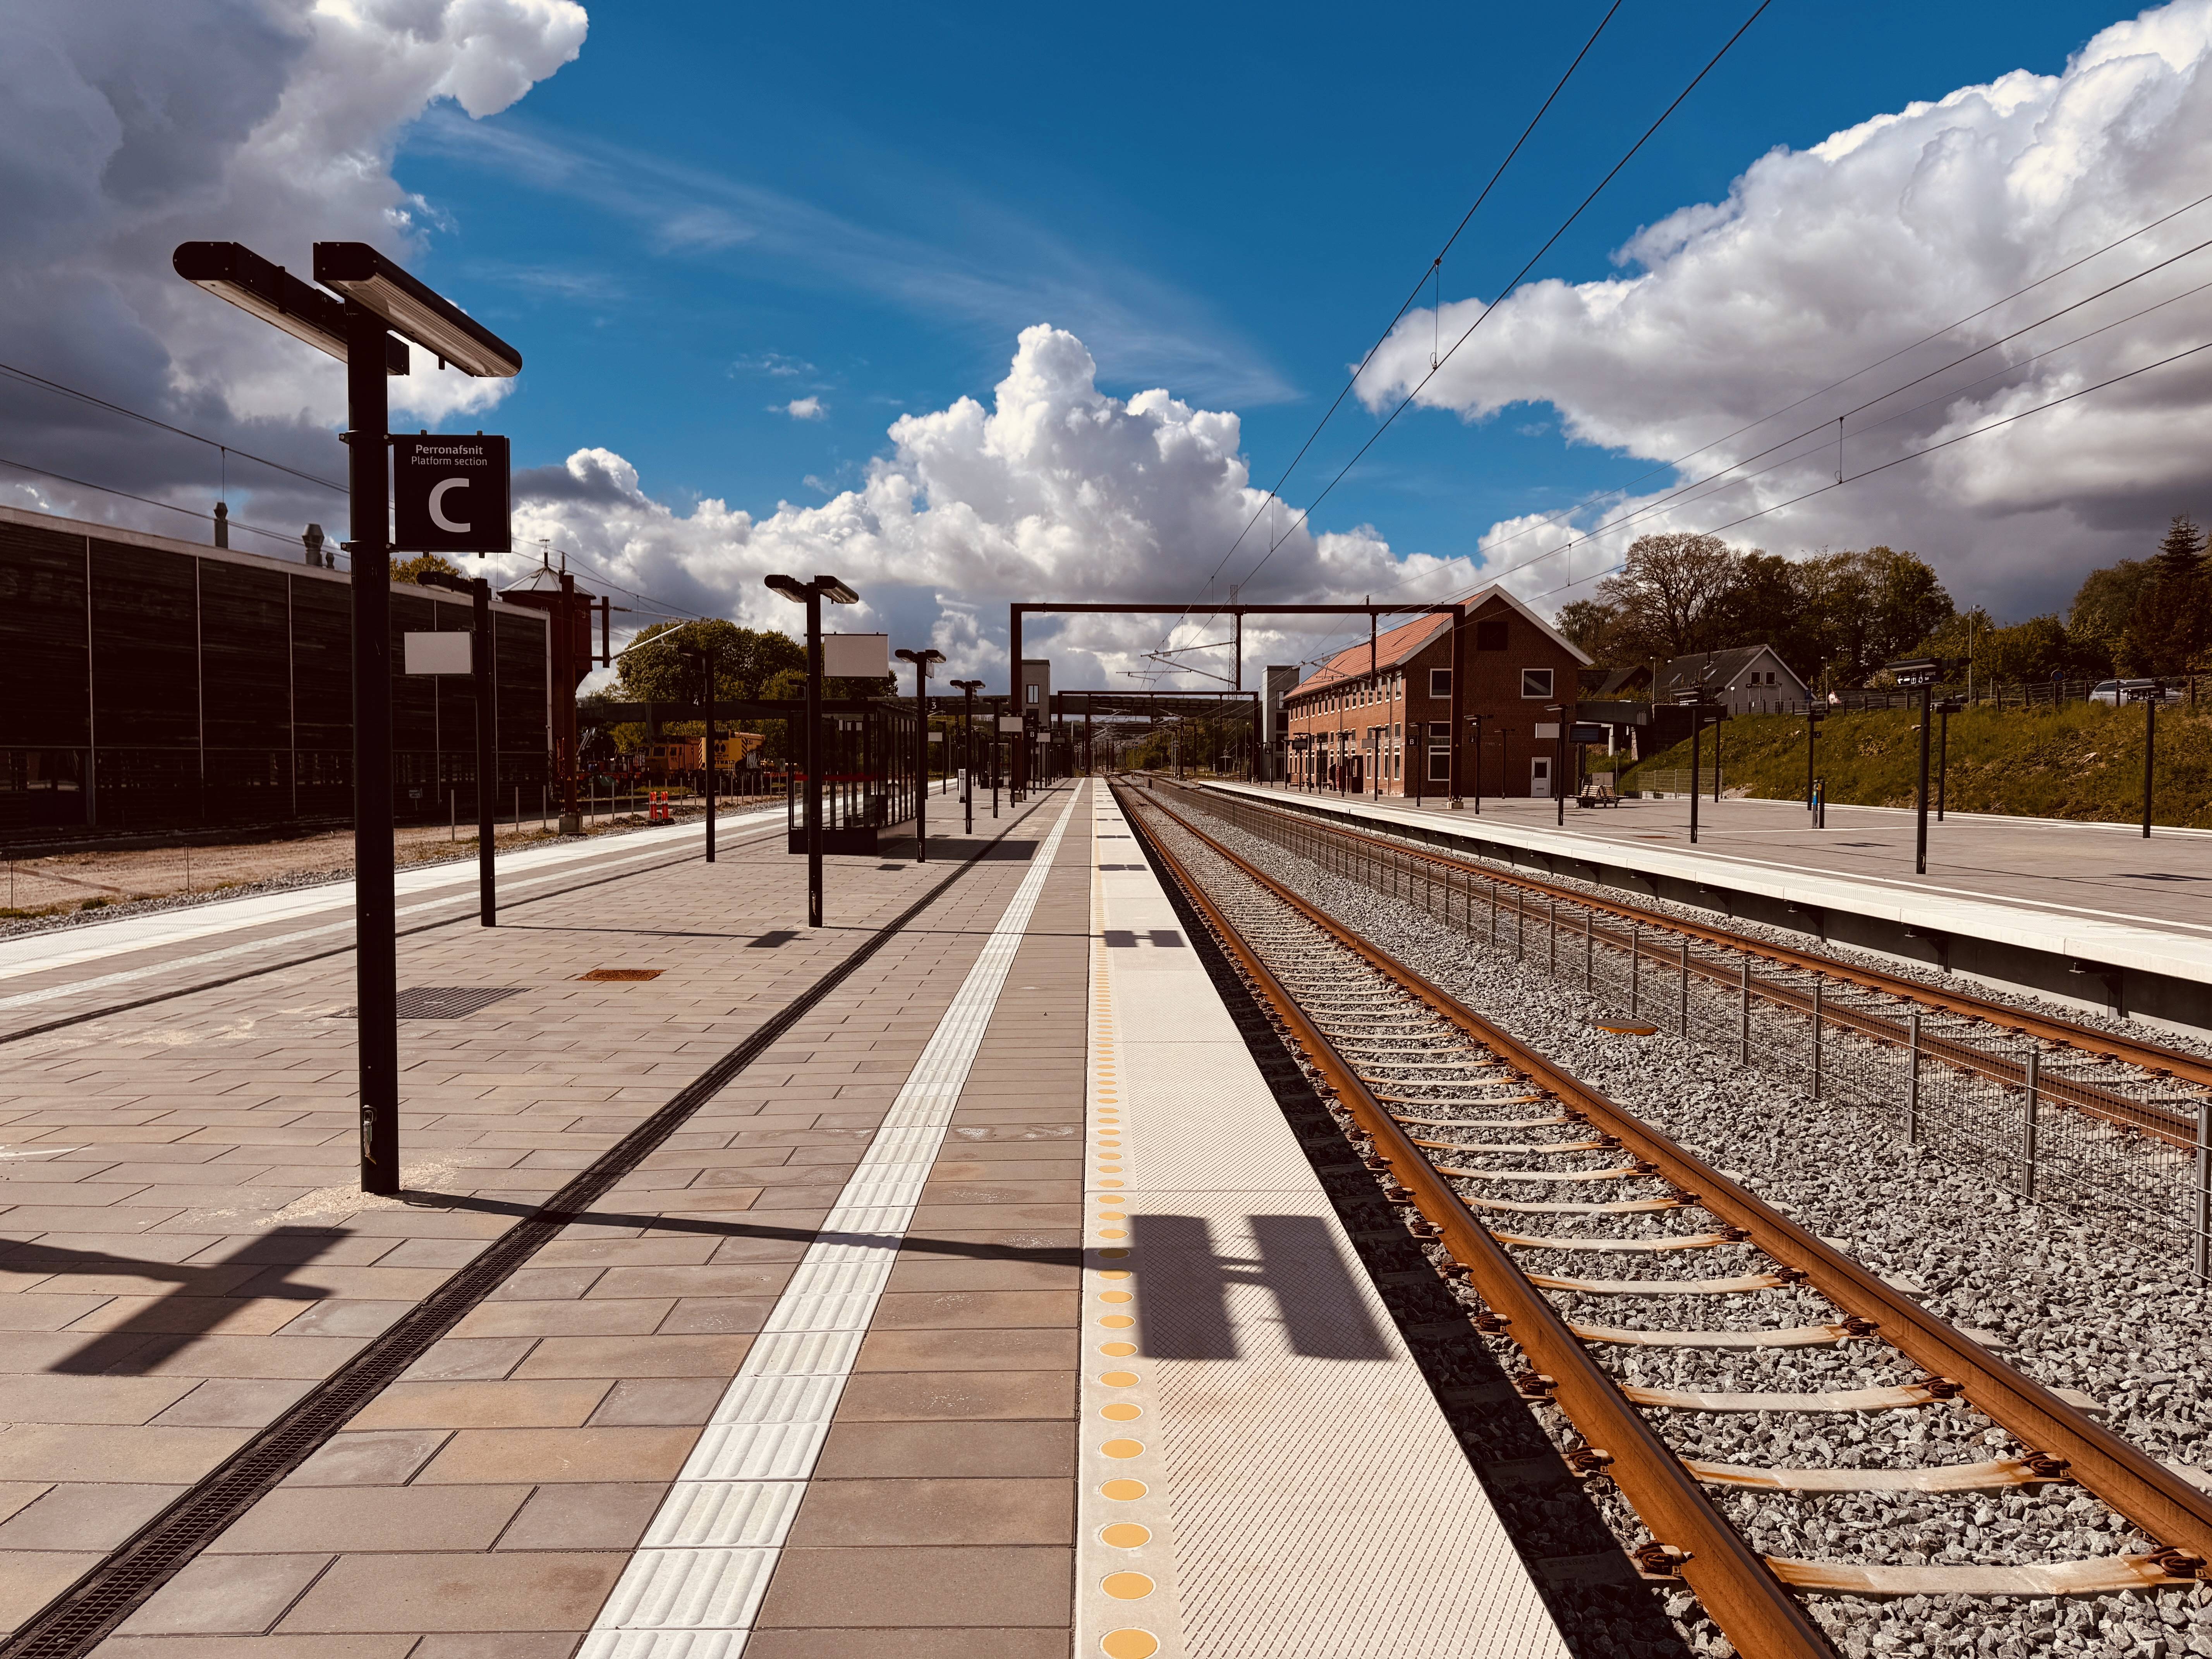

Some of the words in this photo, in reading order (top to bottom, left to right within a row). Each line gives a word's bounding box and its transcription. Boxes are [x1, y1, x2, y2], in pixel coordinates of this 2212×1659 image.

[416, 444, 483, 455] Perronafsnit
[411, 456, 451, 465] Platform
[454, 457, 487, 465] section
[429, 477, 471, 533] C
